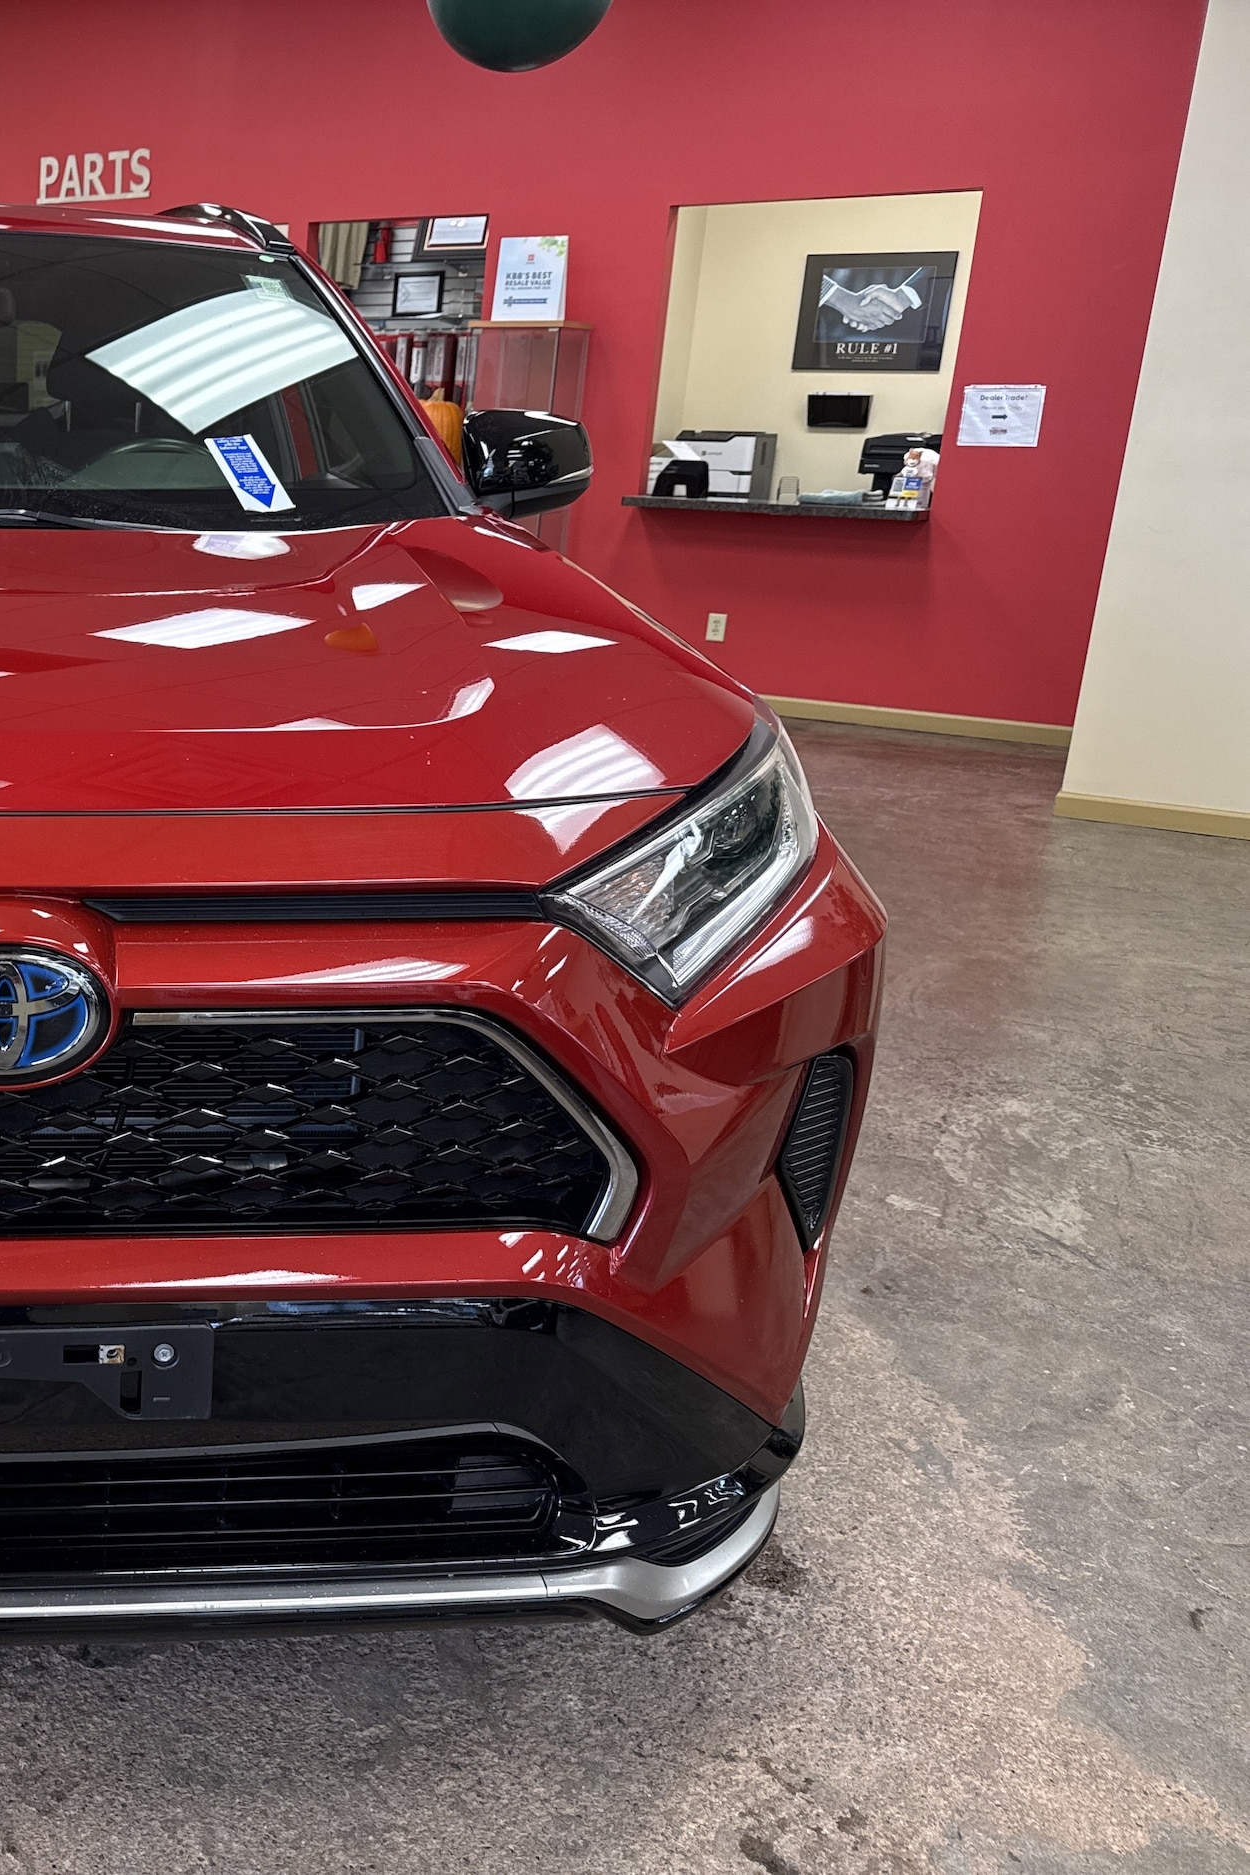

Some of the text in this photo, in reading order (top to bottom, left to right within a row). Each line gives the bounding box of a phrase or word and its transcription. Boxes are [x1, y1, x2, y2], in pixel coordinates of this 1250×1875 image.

[38, 147, 152, 200] PARTS
[531, 271, 553, 280] BEST
[530, 279, 552, 287] VALUE
[835, 342, 899, 355] RULE #1
